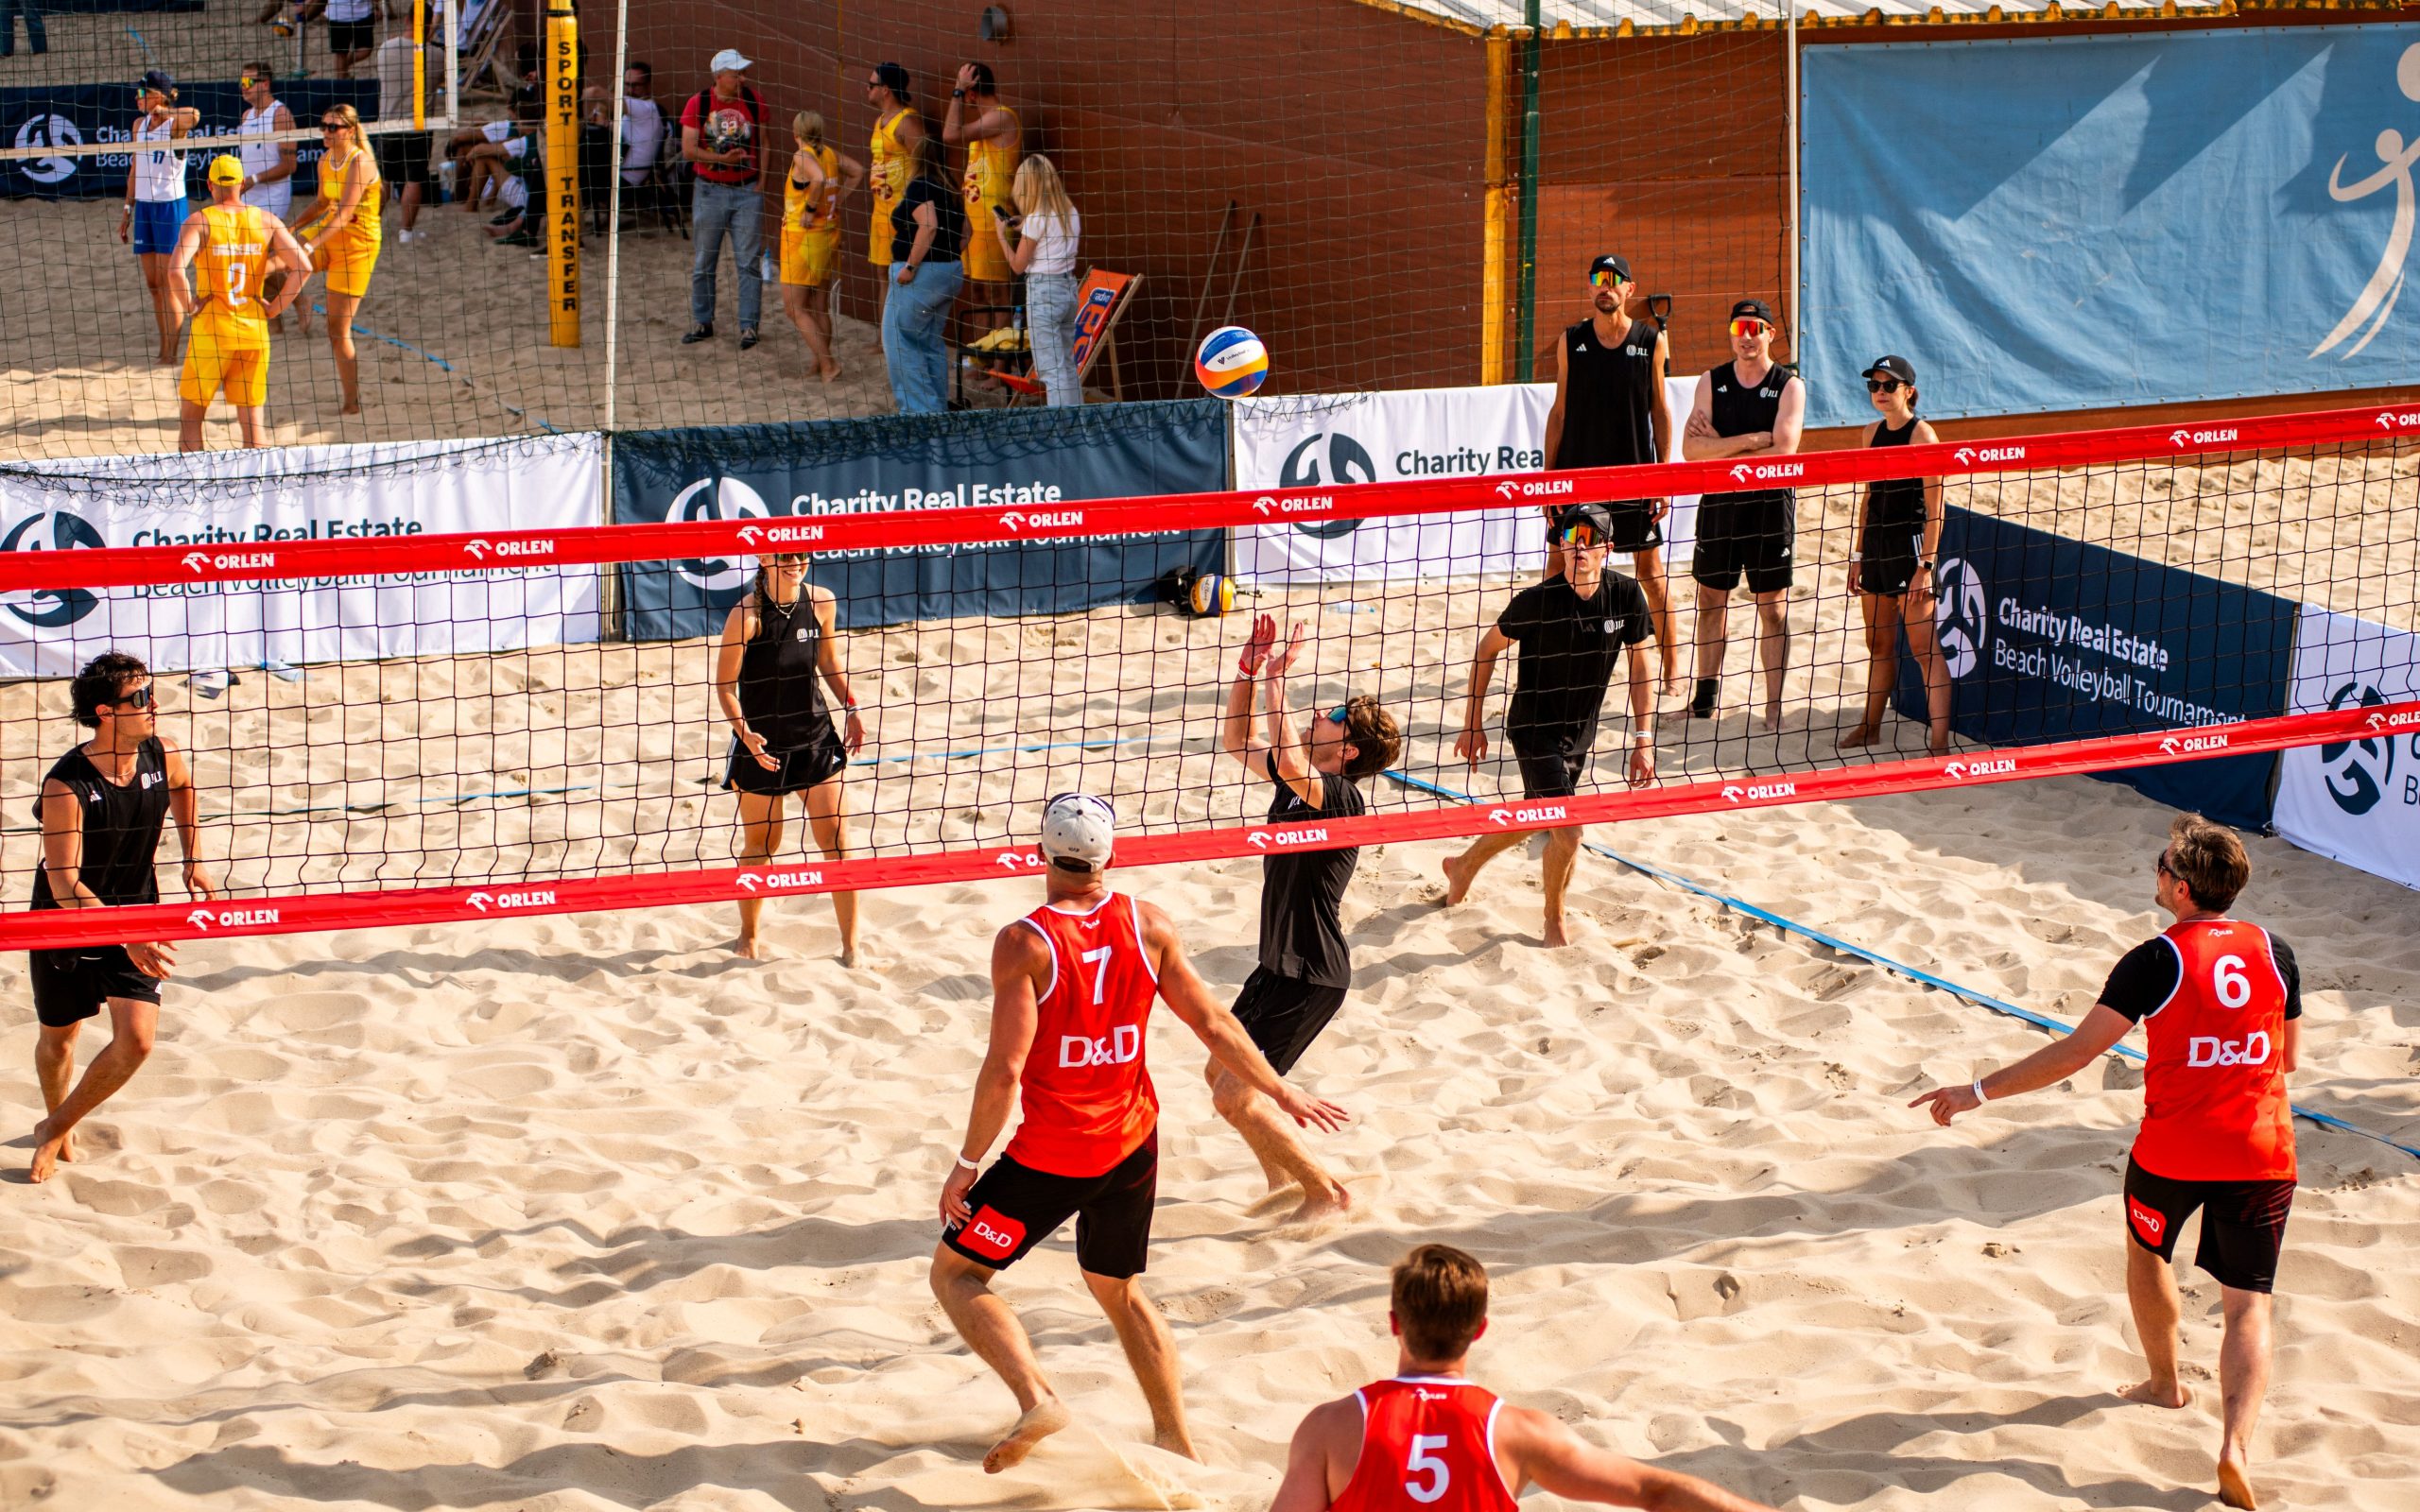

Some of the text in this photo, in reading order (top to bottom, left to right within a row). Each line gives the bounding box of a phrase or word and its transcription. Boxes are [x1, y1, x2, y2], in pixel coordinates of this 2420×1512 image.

[558, 41, 573, 126] SPORT
[560, 176, 576, 312] TRANSFER
[228, 263, 248, 306] 2
[2194, 429, 2238, 444] ORLEN
[1395, 446, 1544, 475] Charity Rea
[1979, 446, 2025, 462] ORLEN
[1756, 463, 1804, 479] ORLEN
[1523, 480, 1573, 496] ORLEN
[1281, 496, 1332, 512] ORLEN
[1029, 511, 1082, 528] ORLEN
[767, 525, 823, 542] ORLEN
[496, 540, 554, 557] ORLEN
[215, 552, 274, 570] ORLEN
[1998, 597, 2169, 672] Charity Real Estate
[1995, 638, 2047, 680] Beach
[2051, 653, 2131, 705] Volleyball
[2184, 734, 2228, 751] ORLEN
[1970, 759, 2015, 775] ORLEN
[1748, 782, 1795, 800] ORLEN
[1516, 806, 1566, 823] ORLEN
[1276, 828, 1327, 845] ORLEN
[767, 870, 823, 888] ORLEN
[498, 891, 555, 908] ORLEN
[220, 909, 279, 927] ORLEN
[1082, 945, 1112, 1005] 7
[2214, 954, 2250, 1008] 6
[1059, 1023, 1139, 1068] D&D
[2187, 1030, 2271, 1067] D&D
[974, 1221, 1012, 1247] D&D
[1406, 1435, 1449, 1503] 5
